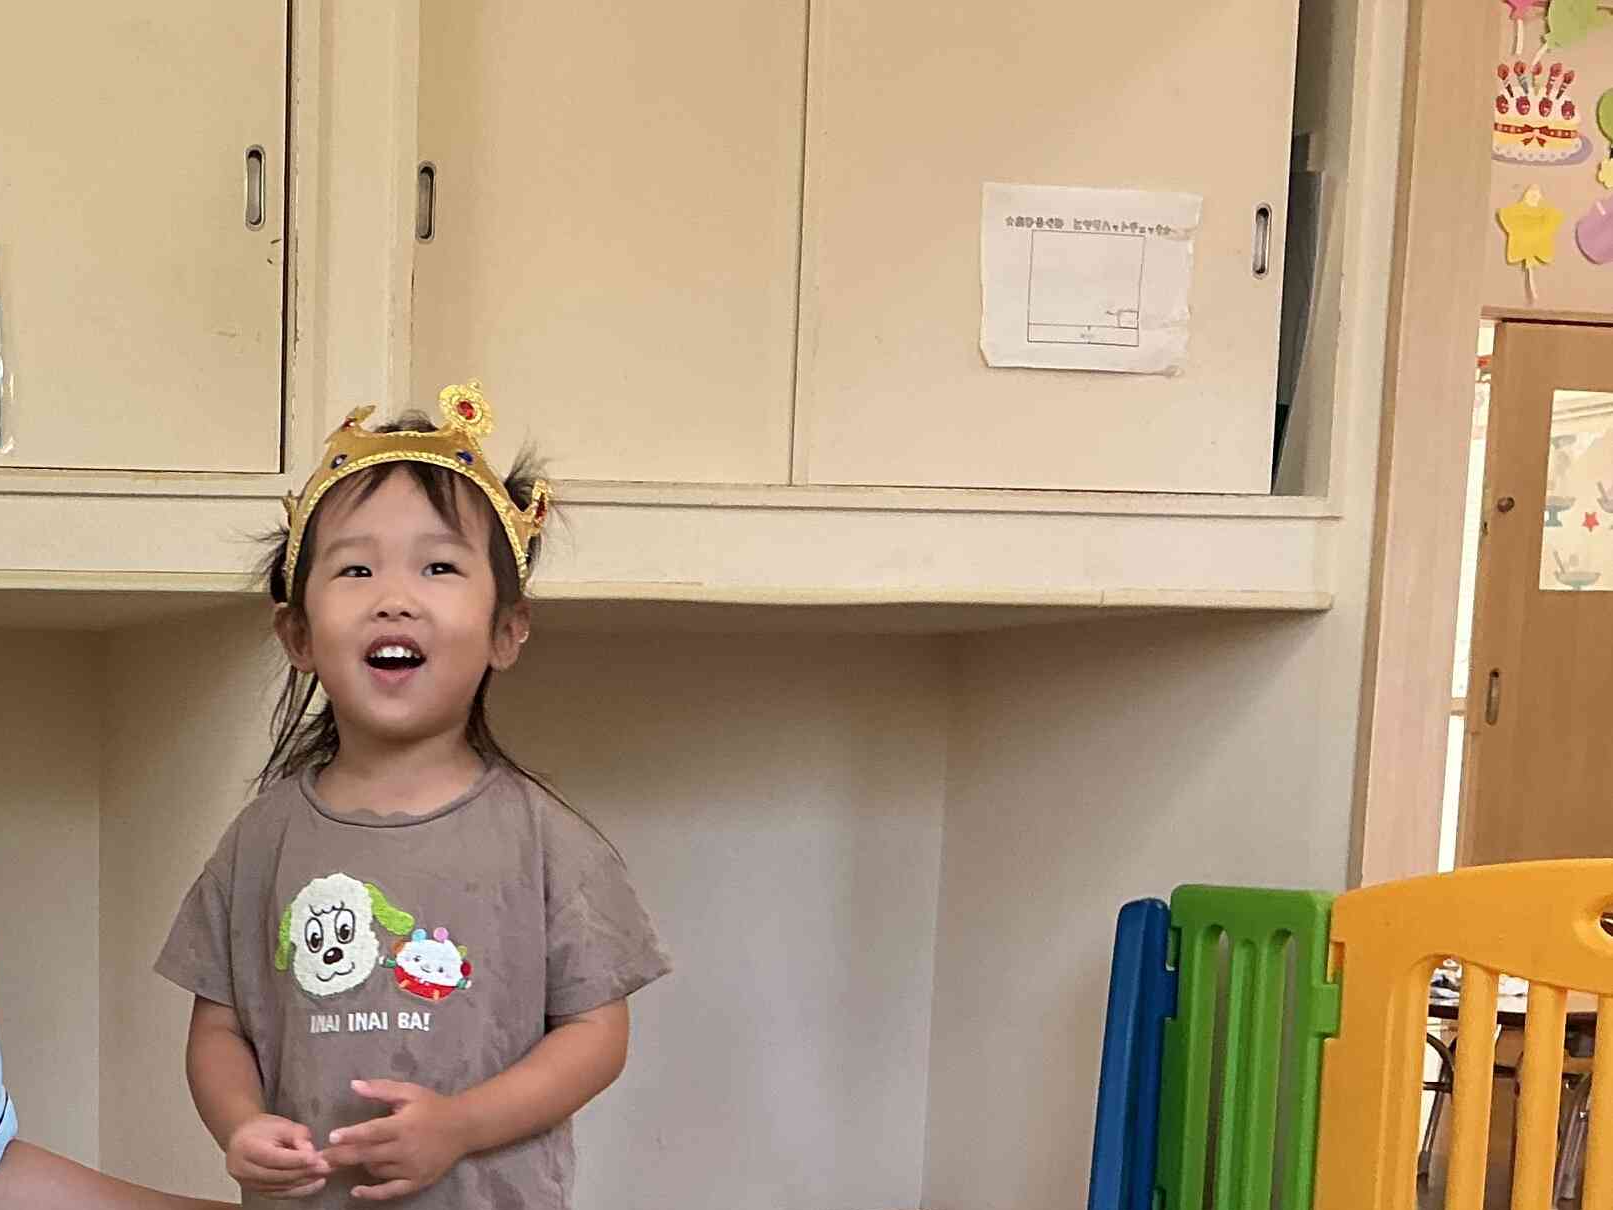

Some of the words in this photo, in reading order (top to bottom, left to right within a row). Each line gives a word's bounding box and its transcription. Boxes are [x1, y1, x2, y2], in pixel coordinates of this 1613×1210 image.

[310, 1013, 340, 1034] INAI
[348, 1012, 388, 1032] INAI
[397, 1011, 431, 1032] BA!
